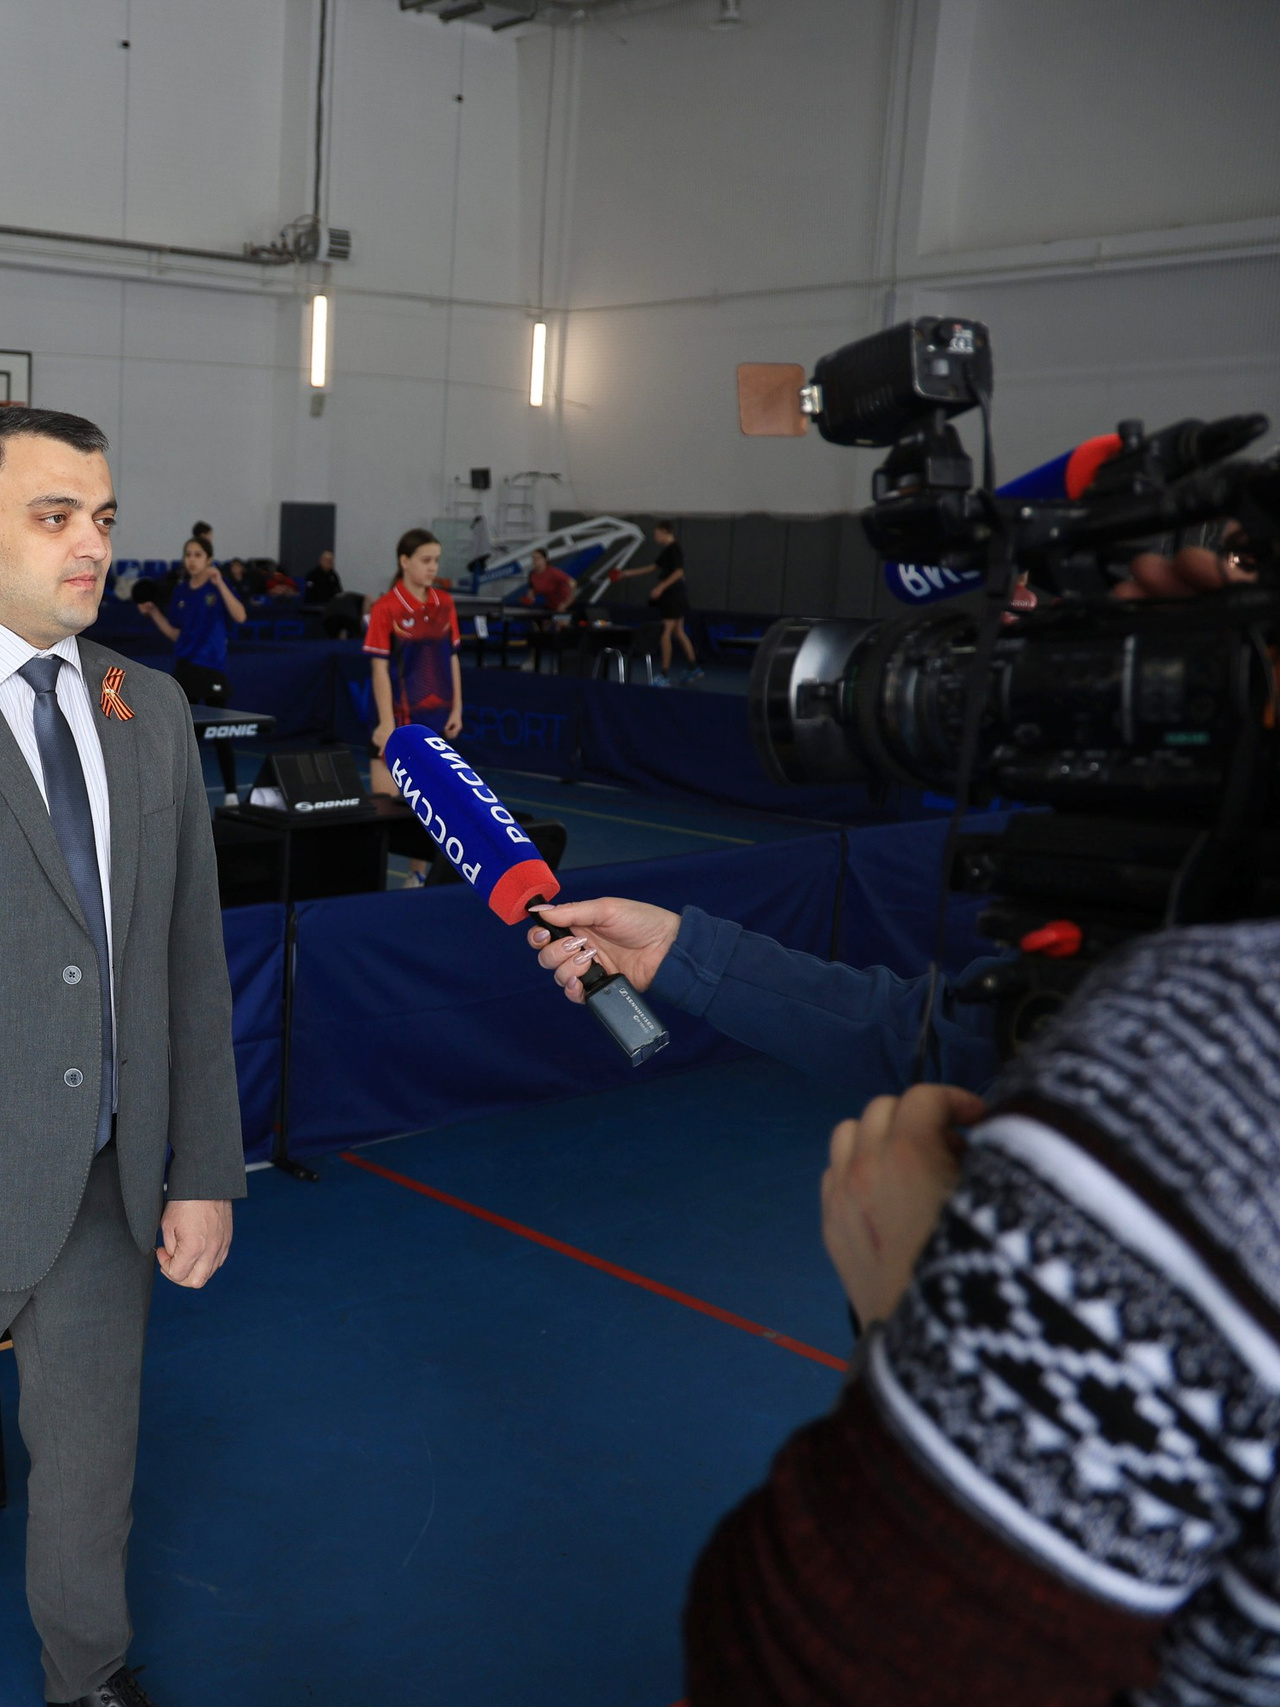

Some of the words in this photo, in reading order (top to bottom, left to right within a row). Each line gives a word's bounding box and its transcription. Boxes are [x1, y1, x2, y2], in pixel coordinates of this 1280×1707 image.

[203, 723, 259, 740] DONIC
[314, 797, 361, 810] DONIC
[424, 736, 532, 844] РОССИЯ
[391, 757, 483, 886] РОССИЯ
[625, 995, 655, 1030] SENNHEISER
